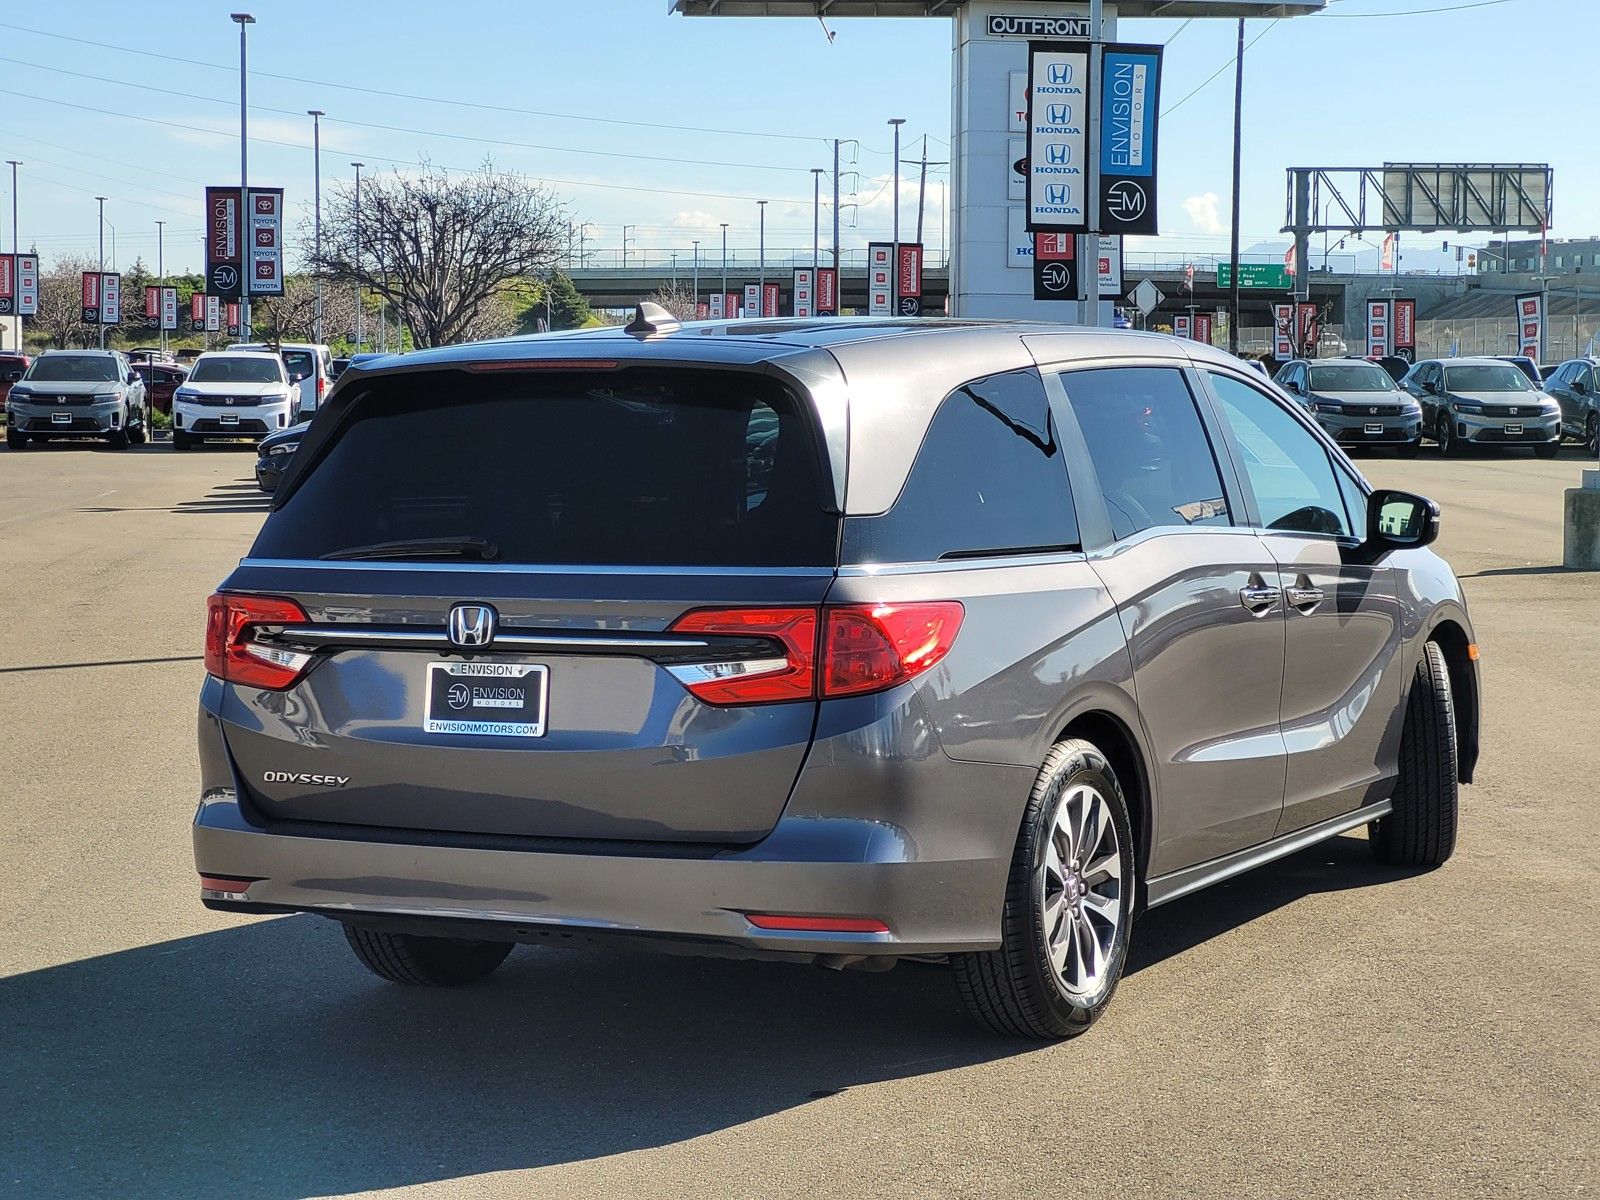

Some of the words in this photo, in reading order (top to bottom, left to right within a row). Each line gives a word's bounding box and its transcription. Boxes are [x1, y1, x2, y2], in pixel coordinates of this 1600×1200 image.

[991, 17, 1091, 36] OUTFRONT
[1036, 86, 1082, 94] HONDA
[1110, 63, 1133, 166] ENVISION
[1133, 73, 1144, 157] MOTORS
[215, 198, 227, 257] ENVISION
[903, 250, 911, 293] ENVISION
[461, 664, 513, 676] ENVISION
[472, 687, 525, 700] ENVISION
[429, 722, 538, 735] ENVISIONMOTORS.COM
[263, 771, 351, 787] ODYSSEY
